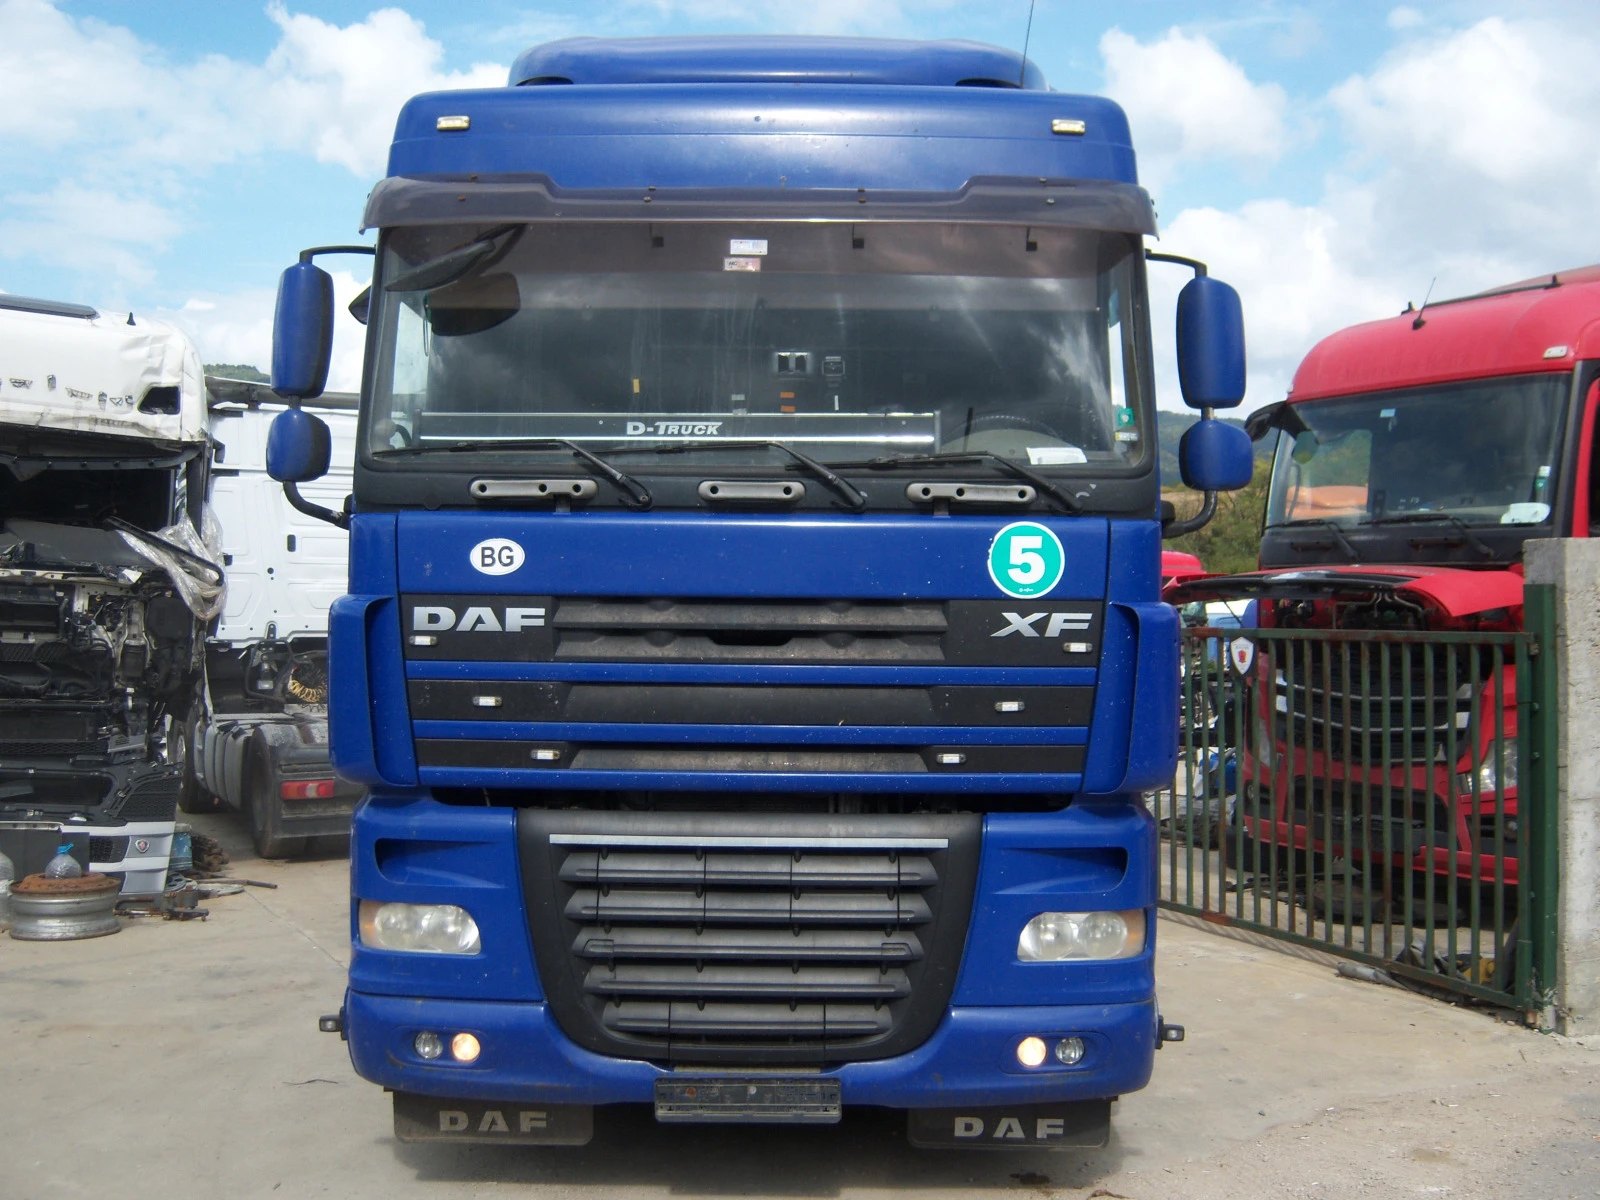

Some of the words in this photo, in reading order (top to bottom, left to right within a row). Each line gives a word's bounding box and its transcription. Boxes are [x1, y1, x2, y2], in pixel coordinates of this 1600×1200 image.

[626, 421, 723, 435] D-TRUCK
[480, 545, 515, 568] BG
[1007, 535, 1046, 585] 5
[413, 606, 546, 632] DAF
[990, 612, 1093, 638] XF
[439, 1110, 547, 1132] DAF
[954, 1116, 1064, 1139] DAF
